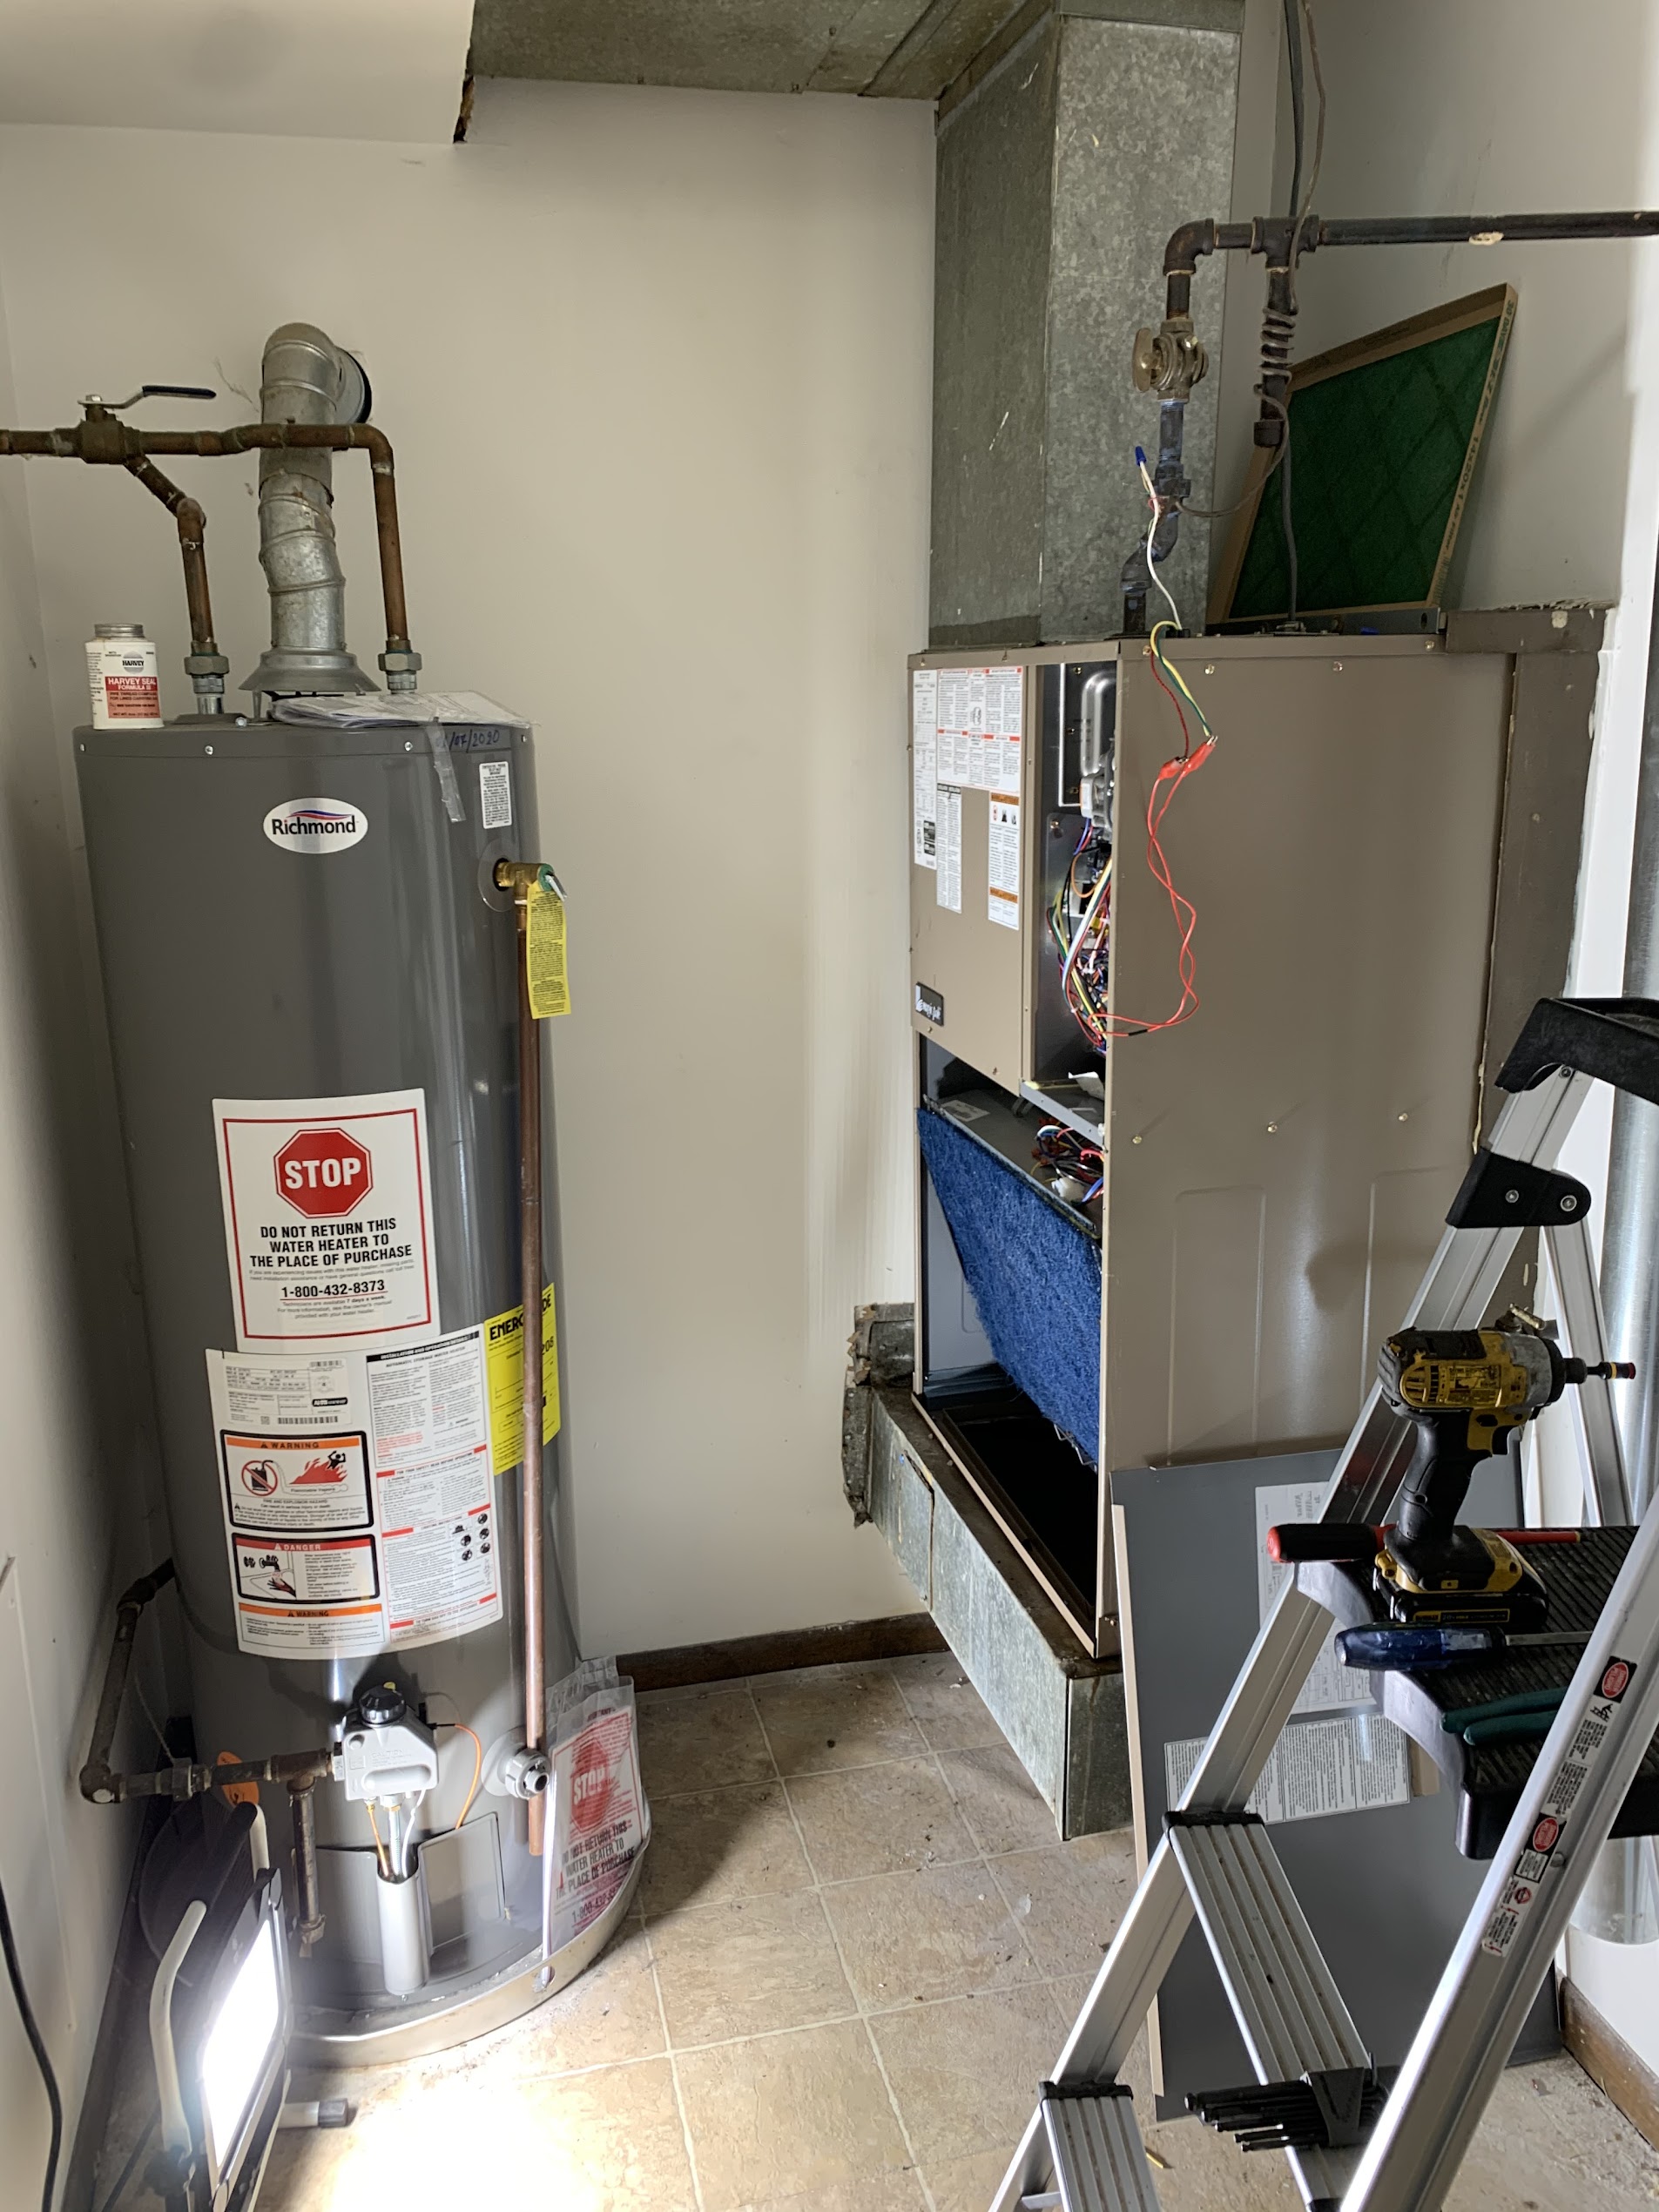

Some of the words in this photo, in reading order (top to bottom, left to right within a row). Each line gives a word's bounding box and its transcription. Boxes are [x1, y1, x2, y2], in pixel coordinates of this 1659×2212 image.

[272, 815, 356, 834] Richmond
[284, 1157, 361, 1190] STOP
[260, 1226, 277, 1238] DO
[281, 1225, 307, 1238] NOT
[311, 1222, 363, 1237] RETURN
[367, 1217, 396, 1232] THIS
[270, 1240, 314, 1253] WATER
[318, 1236, 368, 1251] HEATER
[373, 1233, 389, 1246] TO
[250, 1255, 273, 1267] THE
[277, 1254, 319, 1267] PLACE
[322, 1254, 340, 1265] OF
[344, 1244, 412, 1264] PURCHASE
[281, 1279, 385, 1298] 1-800-432-8373
[573, 1767, 604, 1802] STOP
[589, 1843, 614, 1865] HEATER
[616, 1837, 624, 1852] TO
[568, 1870, 590, 1893] PLACE
